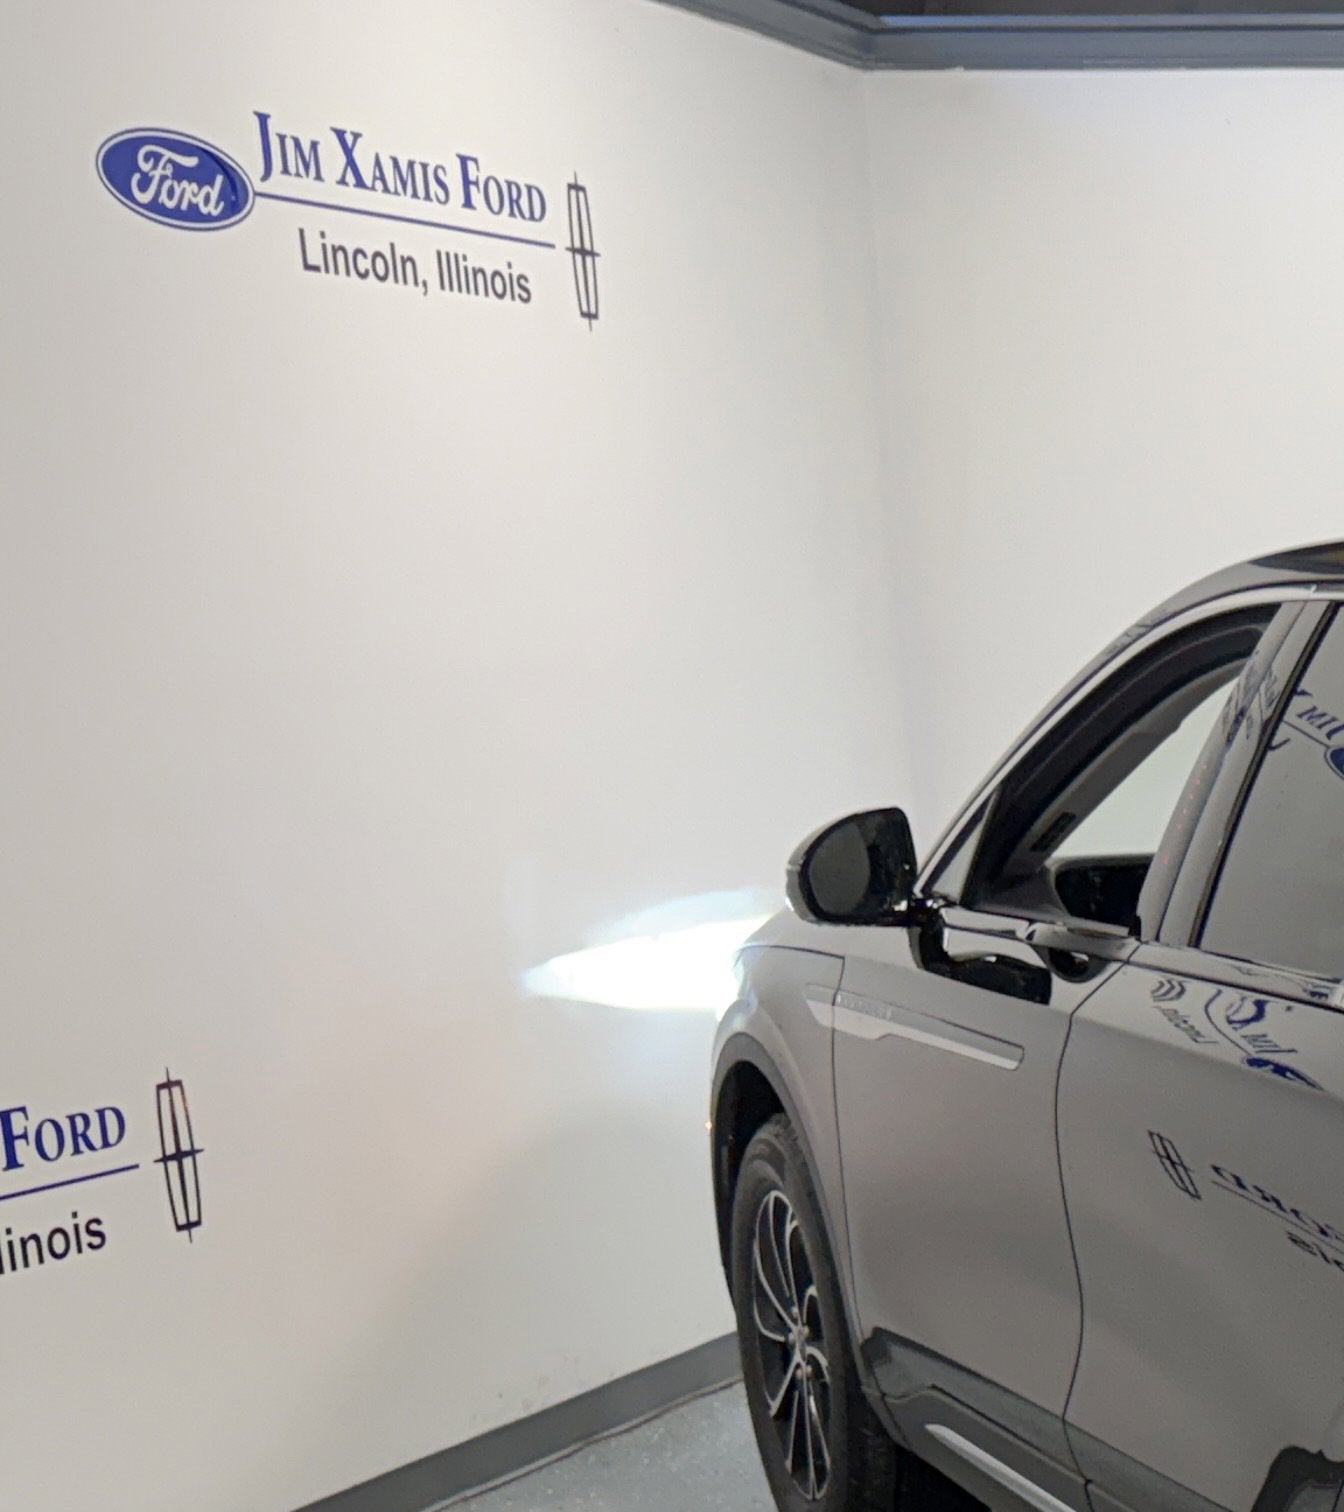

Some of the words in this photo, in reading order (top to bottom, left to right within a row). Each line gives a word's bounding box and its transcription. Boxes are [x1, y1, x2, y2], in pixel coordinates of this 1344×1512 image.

[131, 143, 224, 216] Ford
[252, 111, 323, 182] JIM
[329, 126, 450, 206] XAMIS
[455, 153, 547, 224] FORD
[298, 227, 430, 296] Lincoln,
[436, 250, 533, 304] Illinois
[0, 1106, 126, 1172] FORD
